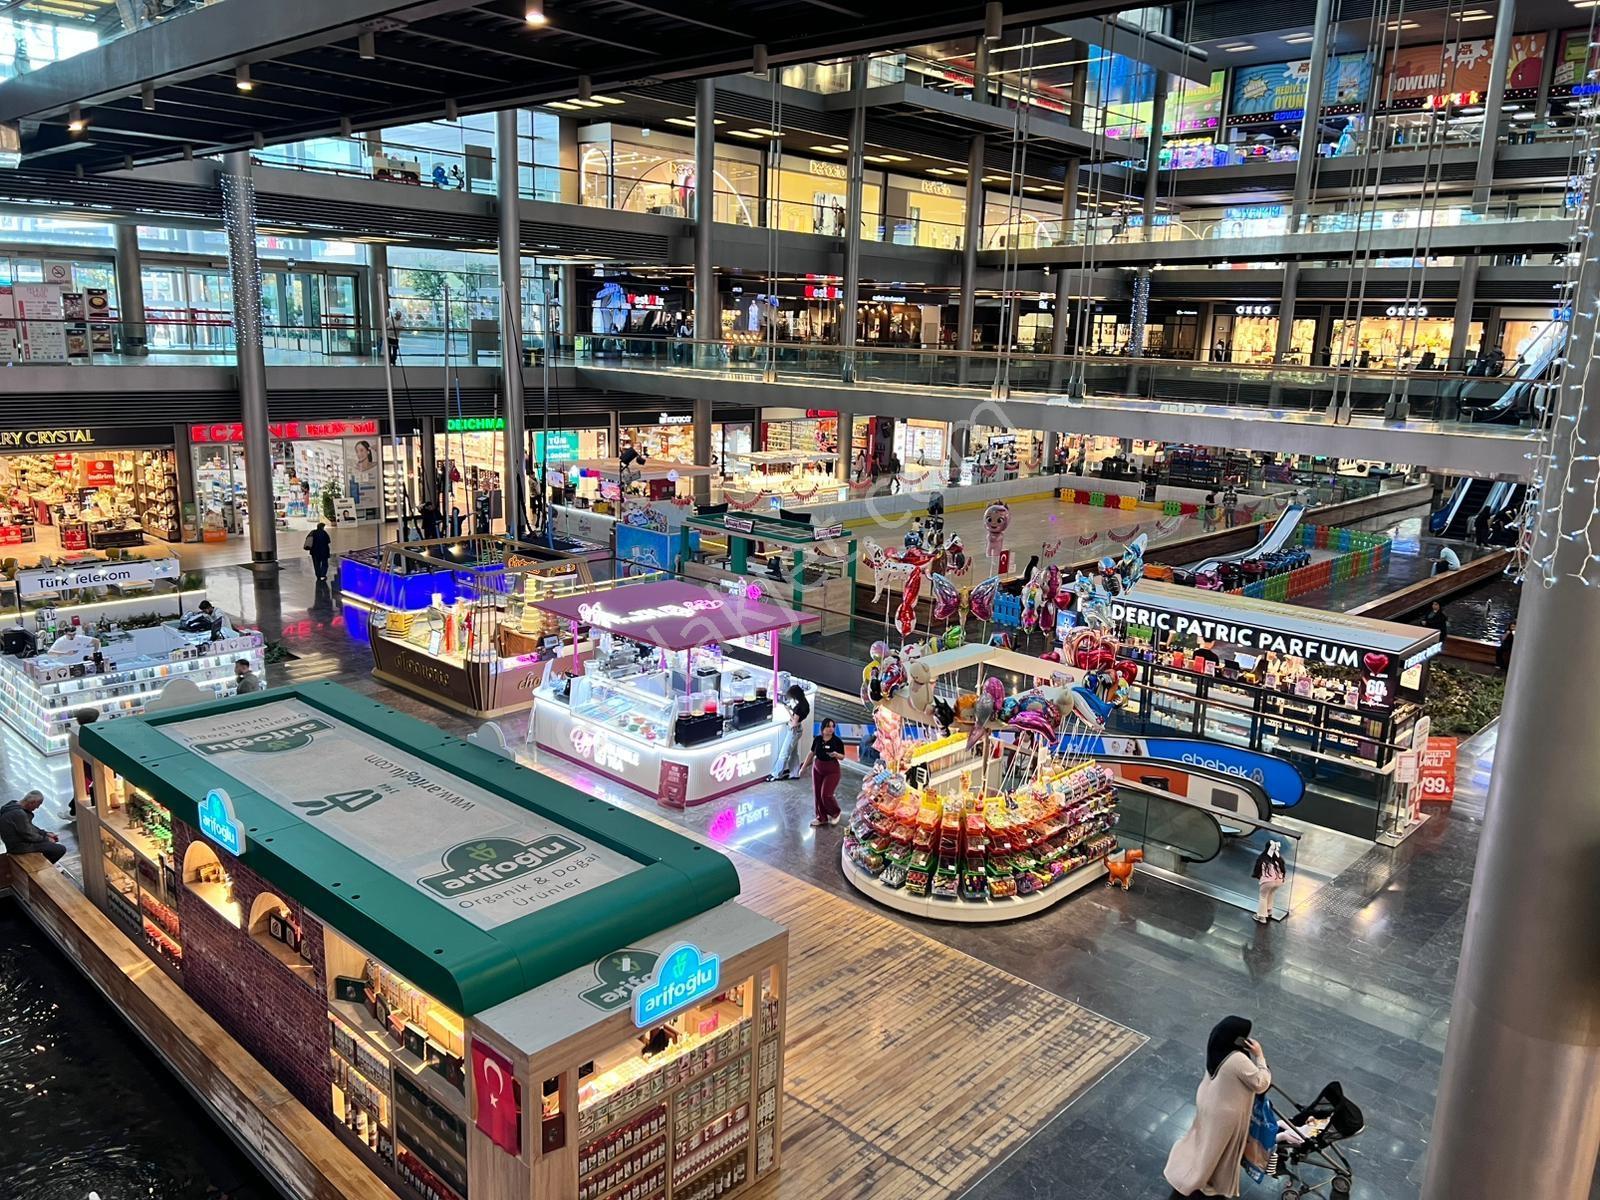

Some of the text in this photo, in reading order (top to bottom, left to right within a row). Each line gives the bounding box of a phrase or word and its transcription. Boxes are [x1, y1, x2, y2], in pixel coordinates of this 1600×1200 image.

[1236, 305, 1271, 315] OXXO
[1386, 306, 1428, 317] OXXO
[25, 428, 96, 445] CRYSTAL
[447, 418, 504, 432] DEICHMA
[38, 577, 69, 589] Türk
[1111, 604, 1359, 668] DERIC PATRIC PARFUM
[1181, 752, 1248, 780] ebebek
[441, 841, 566, 890] arifoğlu
[458, 853, 600, 909] Organik & Doğal
[512, 877, 583, 908] Ürünler
[600, 973, 652, 1003] arifo
[645, 968, 712, 1012] arifoğlu
